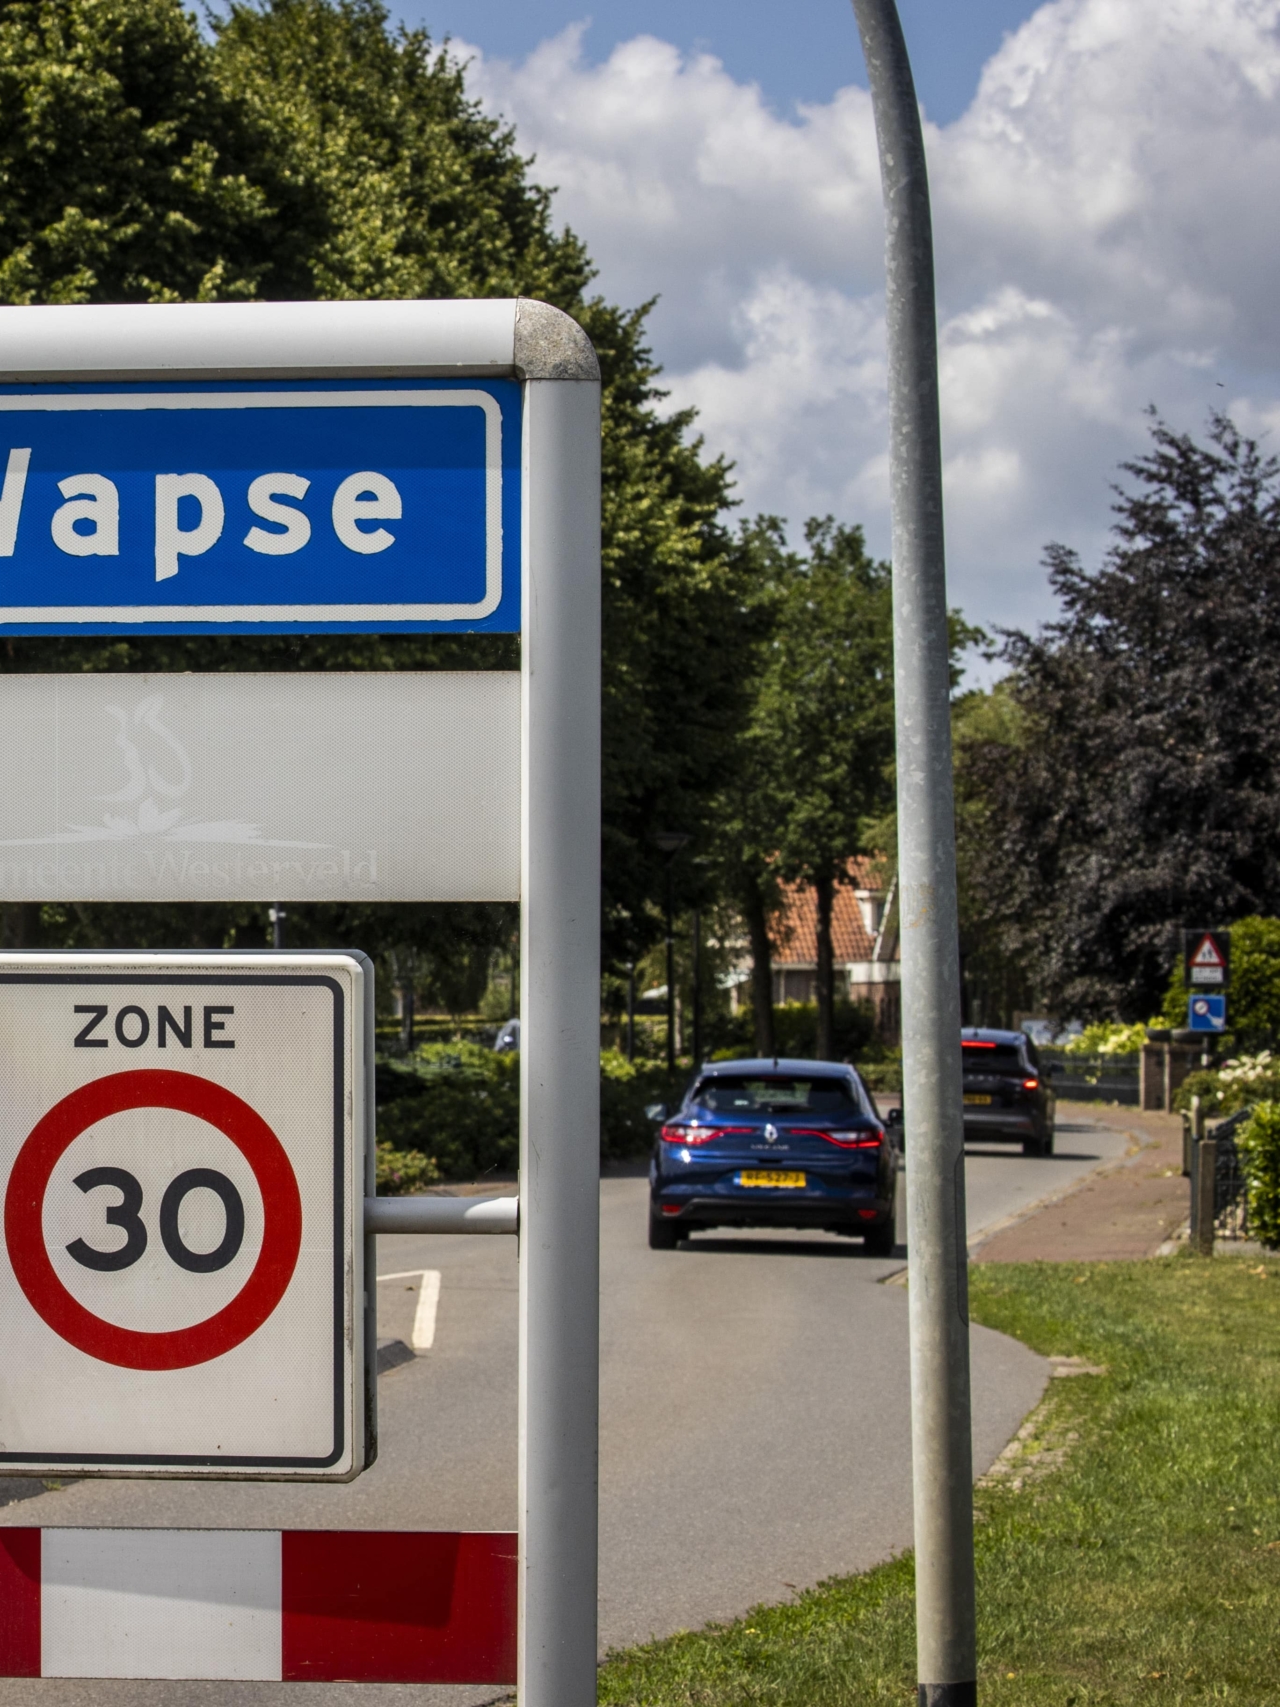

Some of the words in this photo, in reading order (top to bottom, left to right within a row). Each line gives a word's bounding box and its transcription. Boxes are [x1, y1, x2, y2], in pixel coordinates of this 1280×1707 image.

[144, 849, 378, 890] Westerveld
[73, 1004, 236, 1049] ZONE
[65, 1166, 245, 1274] 30
